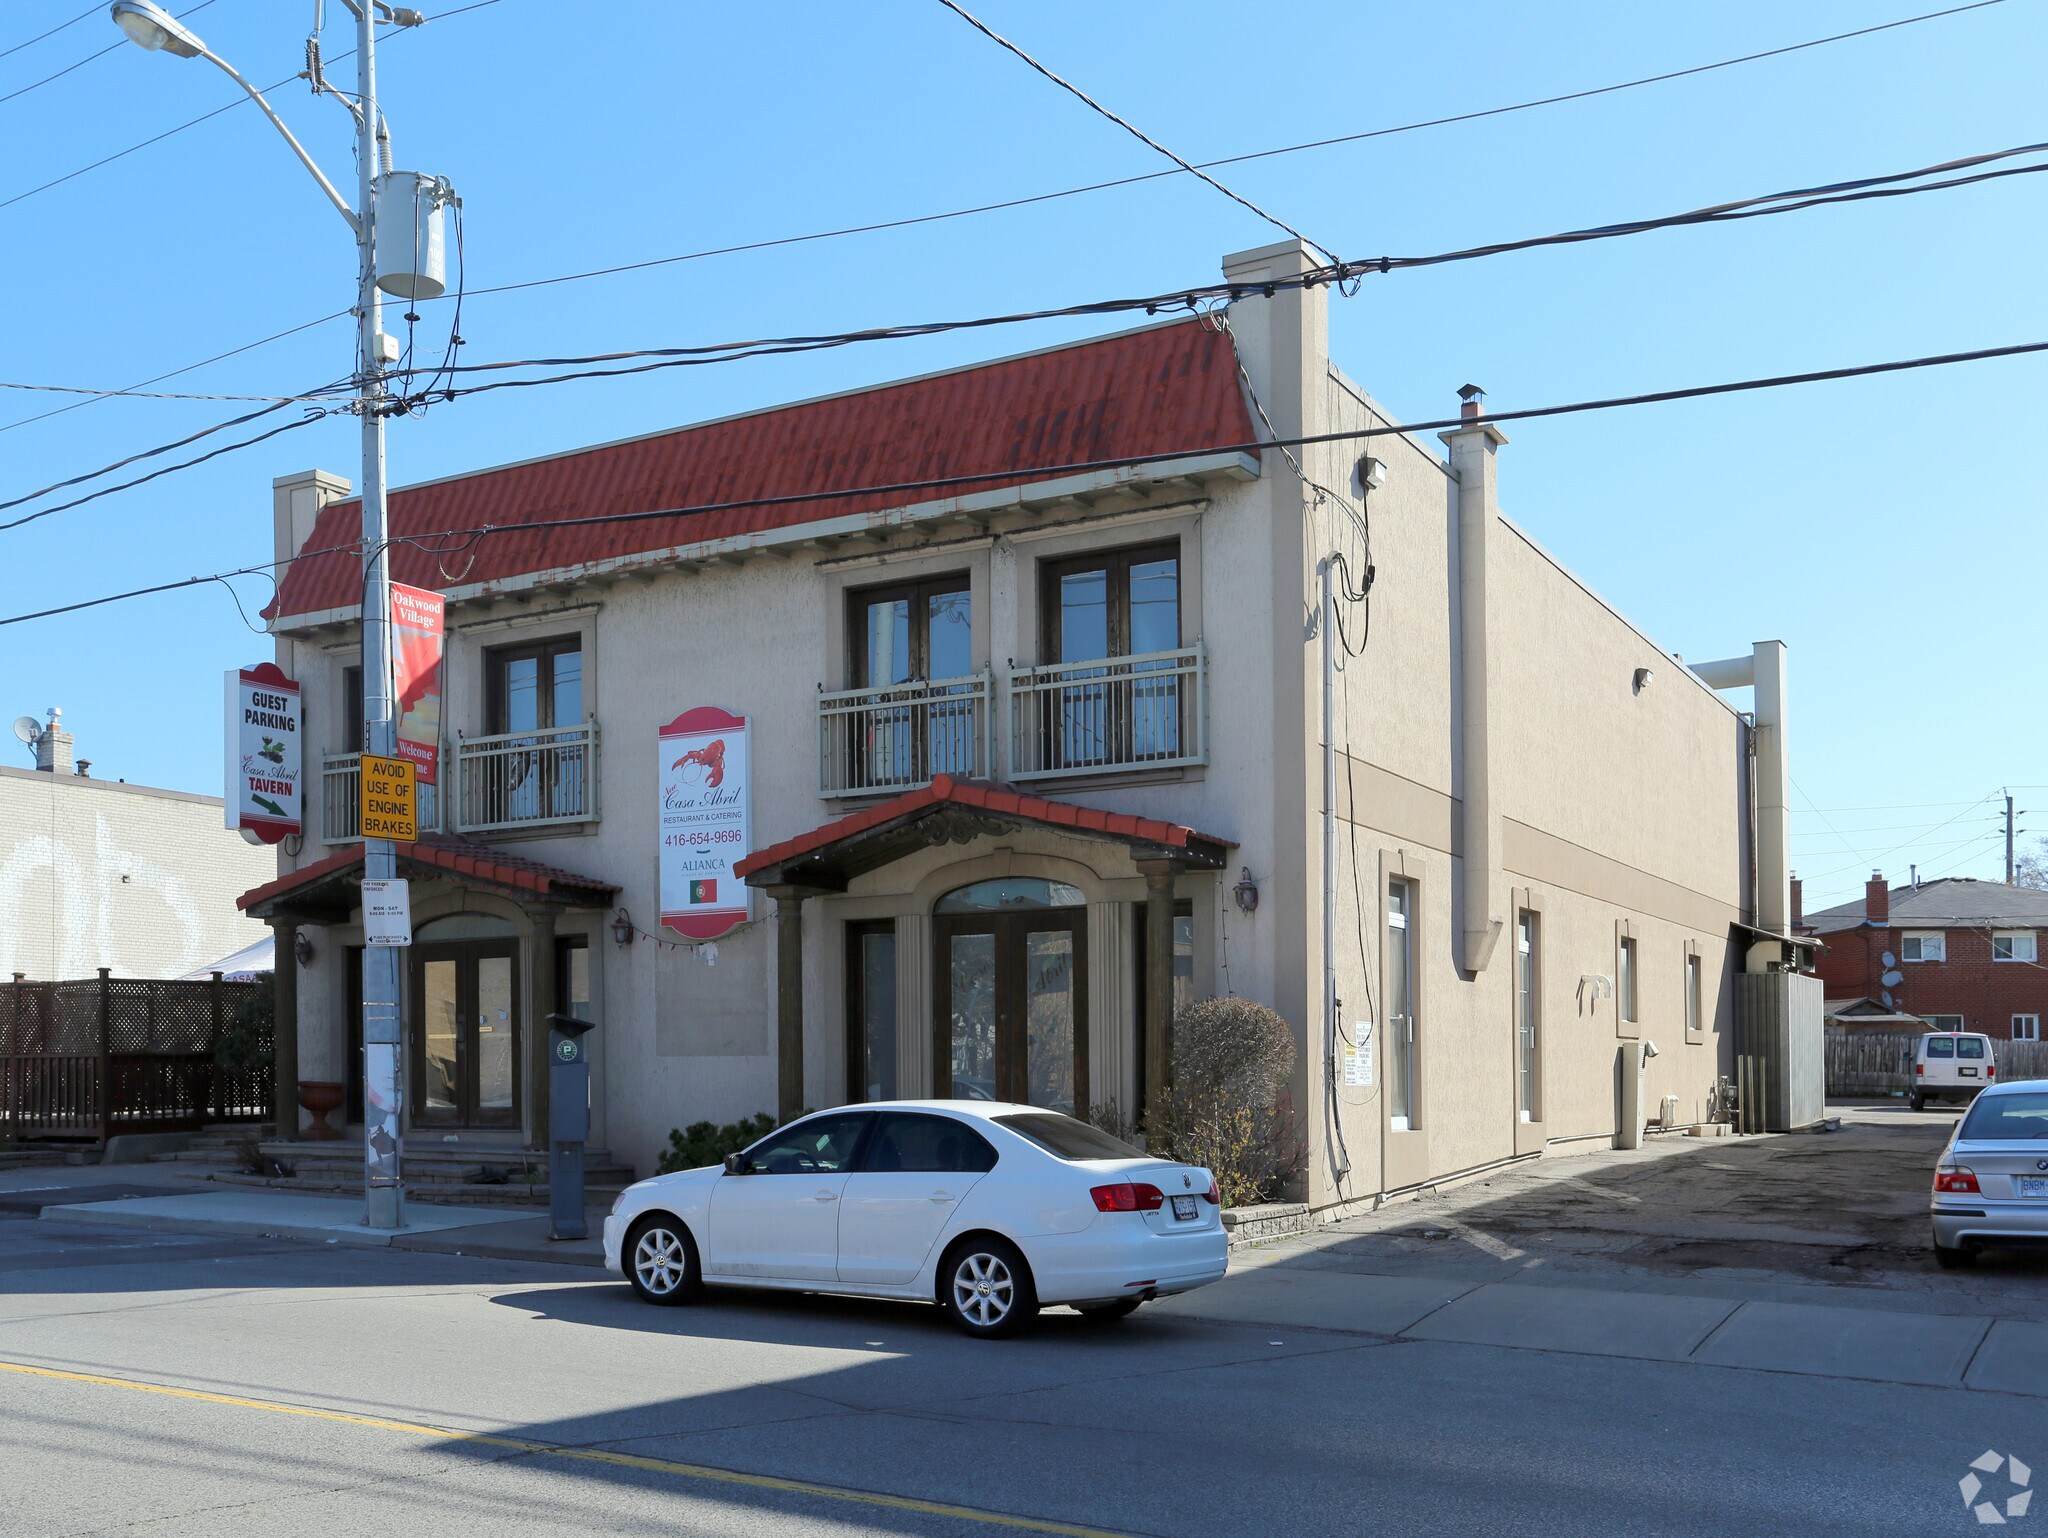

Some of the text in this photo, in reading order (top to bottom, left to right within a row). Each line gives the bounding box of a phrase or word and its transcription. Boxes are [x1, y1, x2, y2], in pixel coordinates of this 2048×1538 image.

[394, 592, 440, 614] Oakwood
[400, 608, 434, 628] Village
[252, 691, 287, 712] GUEST
[245, 709, 295, 732] PARKING
[400, 742, 432, 760] Welcome
[242, 760, 298, 781] Casa Abril
[372, 762, 405, 778] AVOID
[249, 777, 292, 796] TAVERN
[367, 780, 410, 797] USE OF
[665, 786, 741, 810] Casa Abril
[369, 799, 408, 816] ENGINE
[365, 818, 412, 835] BRAKES
[664, 814, 704, 824] RESTAURANT
[711, 811, 742, 820] CATERING
[665, 830, 742, 846] 416-654-9696
